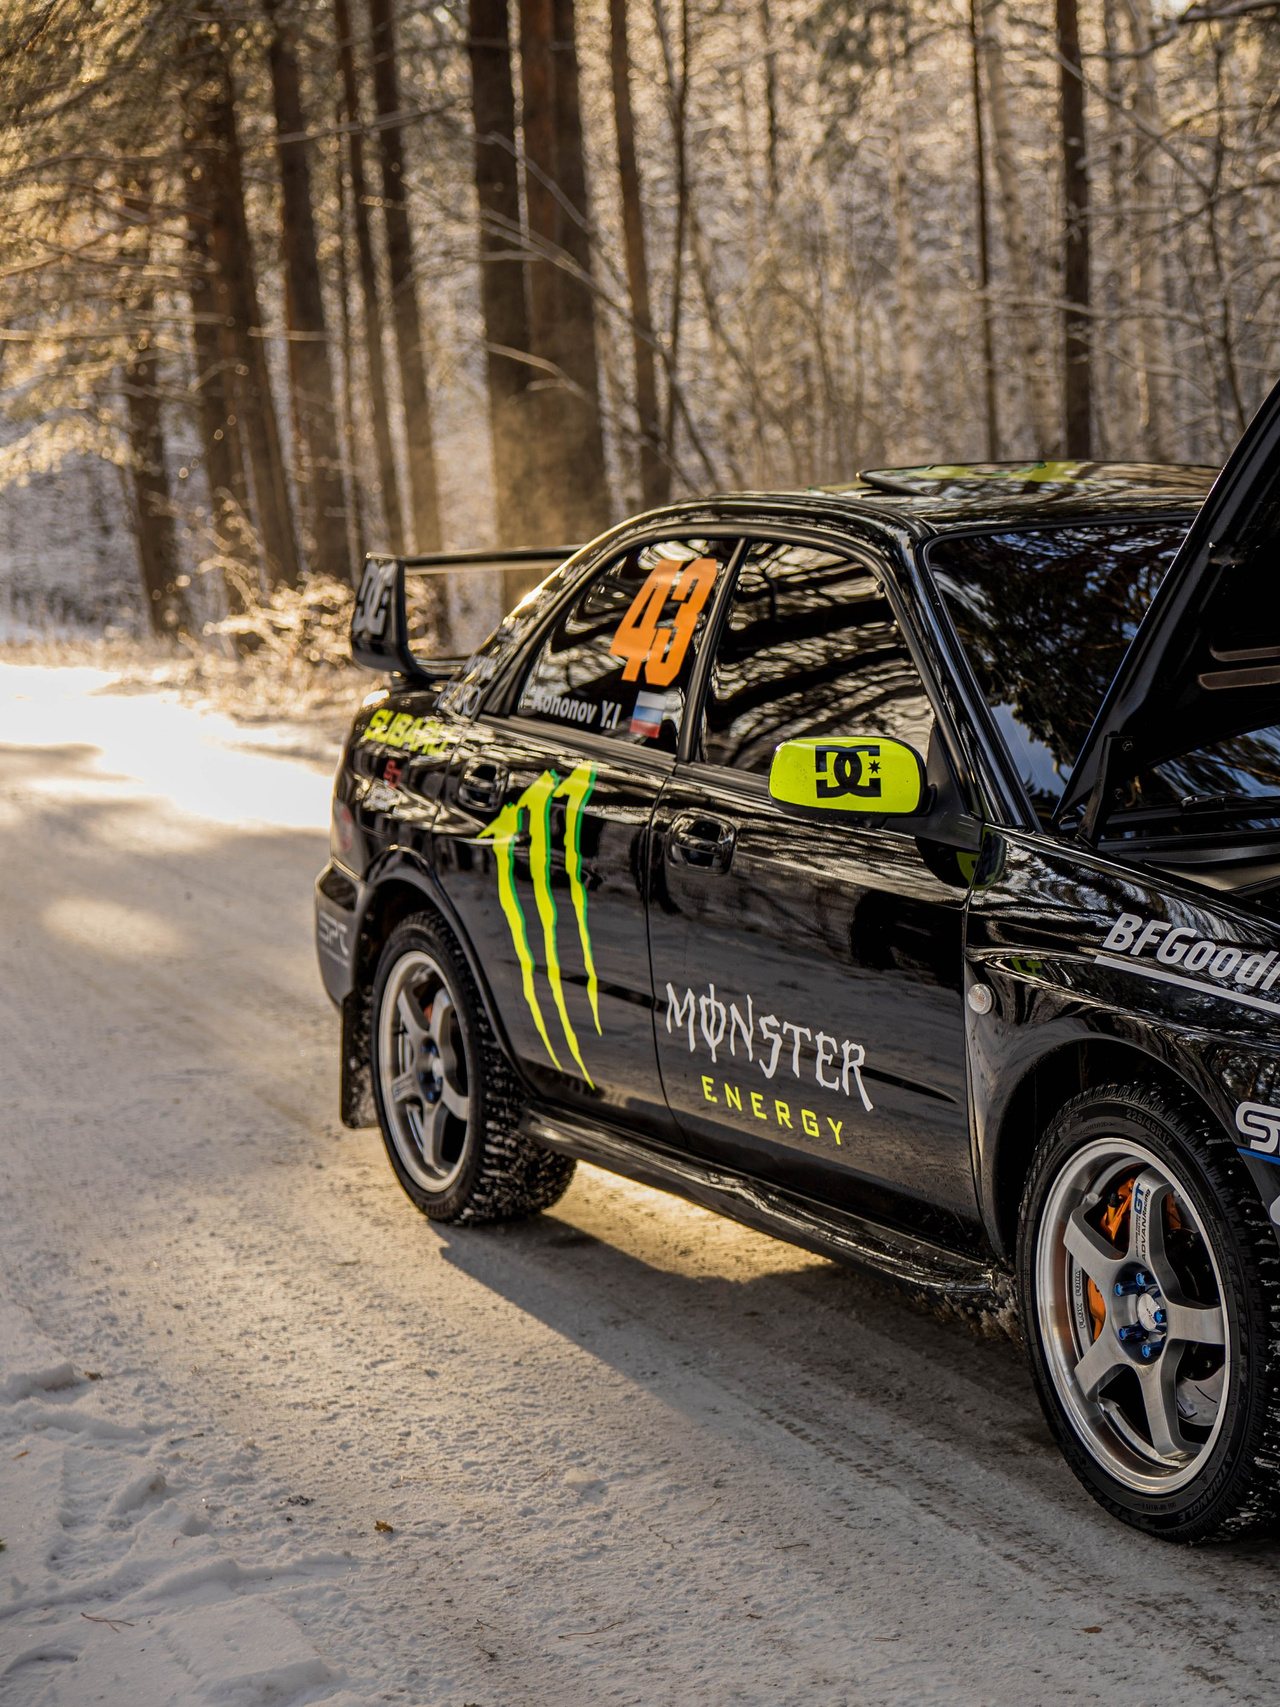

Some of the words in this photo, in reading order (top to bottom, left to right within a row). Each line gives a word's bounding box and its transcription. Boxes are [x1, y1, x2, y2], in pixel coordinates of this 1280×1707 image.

[609, 558, 717, 686] 43
[815, 745, 881, 798] DC
[665, 982, 873, 1111] MONSTER
[701, 1075, 842, 1145] ENERGY
[1126, 1109, 1173, 1145] 225/45R17
[1134, 1183, 1144, 1214] GT
